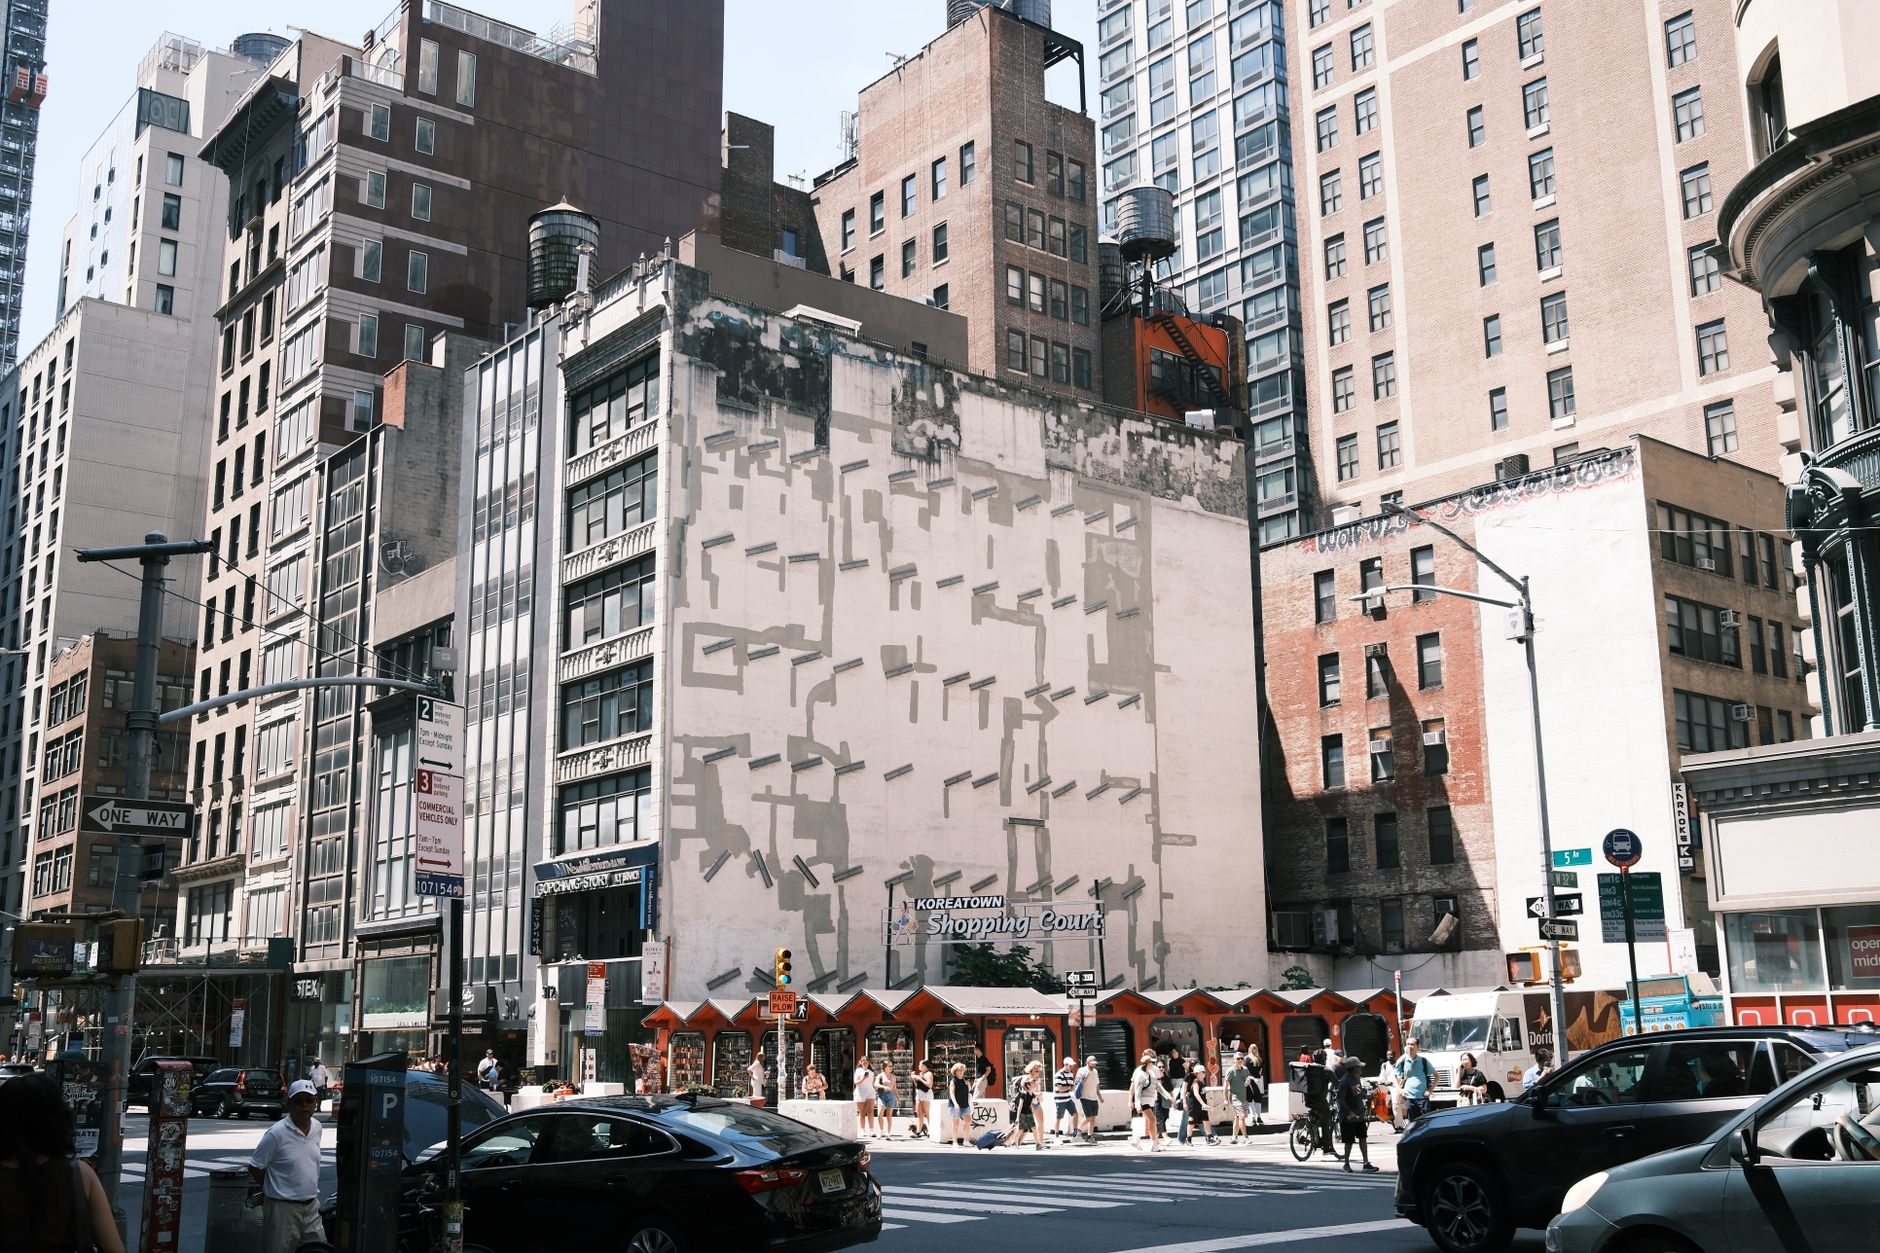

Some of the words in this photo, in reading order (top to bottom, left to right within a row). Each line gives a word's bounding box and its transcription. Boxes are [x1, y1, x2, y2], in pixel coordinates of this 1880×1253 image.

[422, 700, 430, 719] 2
[420, 736, 436, 748] Except
[436, 740, 452, 751] Sunday
[434, 731, 452, 742] Midnight
[421, 772, 428, 792] 3
[418, 800, 454, 814] COMMERCIAL
[100, 808, 131, 823] ONE
[146, 812, 179, 826] WAY
[418, 812, 444, 824] VEHICLES
[444, 816, 458, 826] ONLY
[418, 846, 434, 856] Except
[434, 848, 450, 858] Sunday
[1564, 852, 1571, 864] 5
[1562, 873, 1570, 886] 32
[416, 880, 452, 896] 107154
[917, 897, 1002, 910] KOREATOWN
[1558, 900, 1575, 910] WAY
[927, 912, 1031, 938] Shopping
[1039, 910, 1103, 932] Court
[1544, 924, 1557, 934] ONE
[1561, 926, 1574, 935] WAY
[772, 994, 794, 1002] RAISE
[1529, 1031, 1553, 1046] Dorit
[370, 1073, 397, 1084] 107154
[382, 1093, 398, 1118] P
[972, 1106, 997, 1124] JAY
[372, 1149, 398, 1158] 107154
